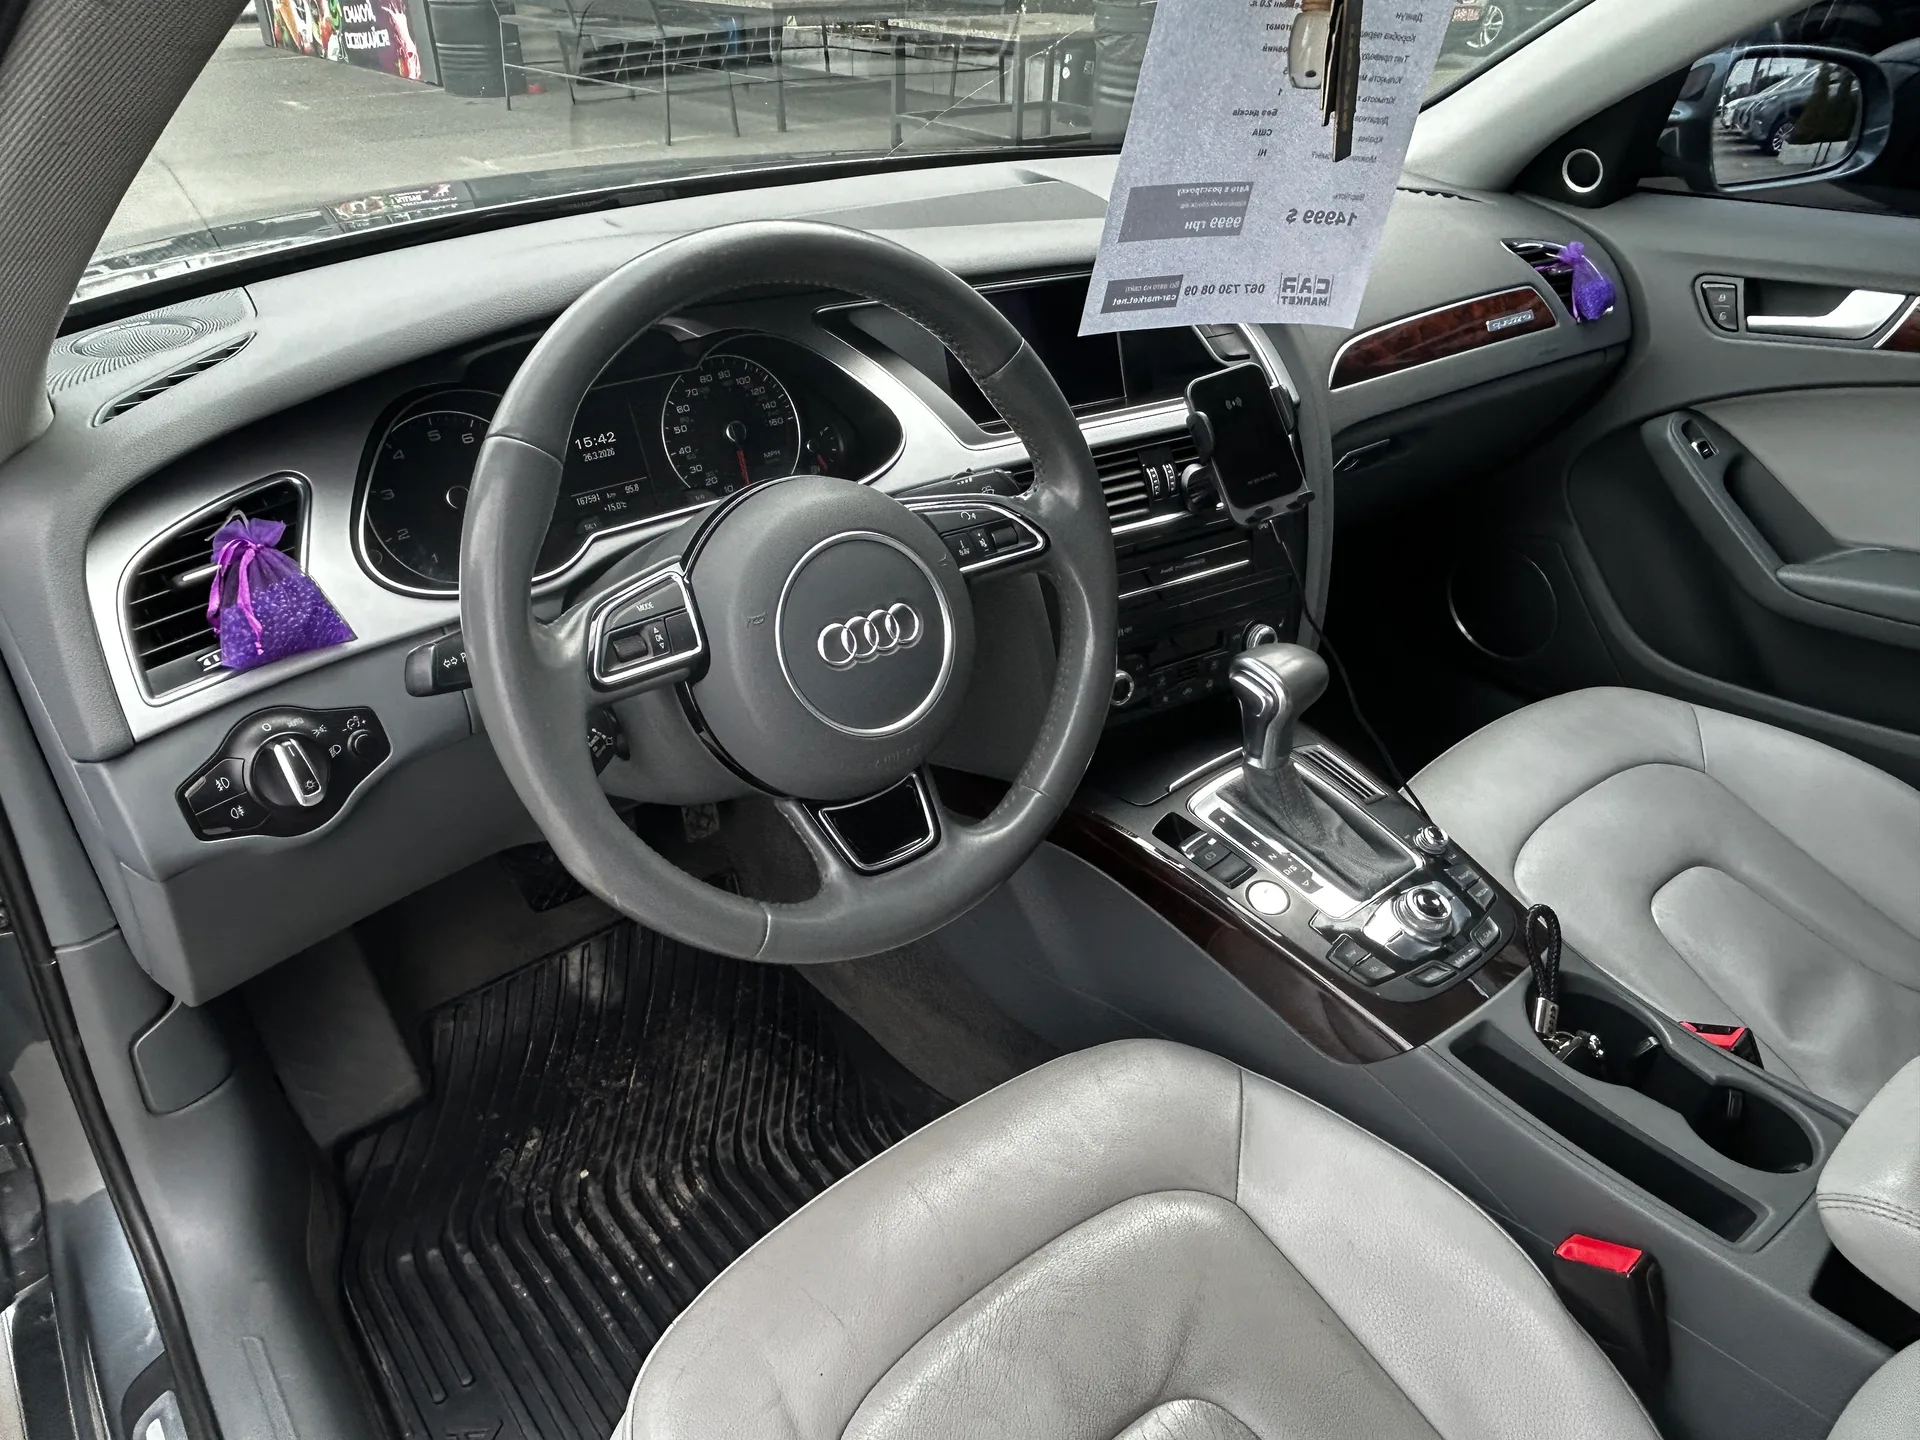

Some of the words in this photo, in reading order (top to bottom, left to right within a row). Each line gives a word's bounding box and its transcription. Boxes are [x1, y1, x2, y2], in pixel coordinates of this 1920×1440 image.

[700, 374, 713, 383] 80
[718, 370, 731, 379] 90
[735, 376, 751, 385] 100
[685, 388, 699, 398] 70
[750, 386, 766, 396] 120
[676, 404, 691, 414] 60
[762, 401, 777, 410] 140
[673, 425, 688, 434] 50
[427, 429, 441, 442] 5
[461, 433, 474, 444] 6
[575, 431, 616, 450] 15:42
[393, 450, 405, 460] 4
[678, 446, 692, 455] 40
[763, 450, 781, 458] MPH
[689, 464, 703, 474] 30
[705, 476, 718, 486] 20
[724, 485, 734, 493] 10
[380, 489, 395, 500] 3
[397, 528, 411, 540] 2
[431, 553, 438, 563] 1
[636, 601, 655, 612] MODE
[1268, 853, 1277, 861] N
[1283, 864, 1298, 876] D/S
